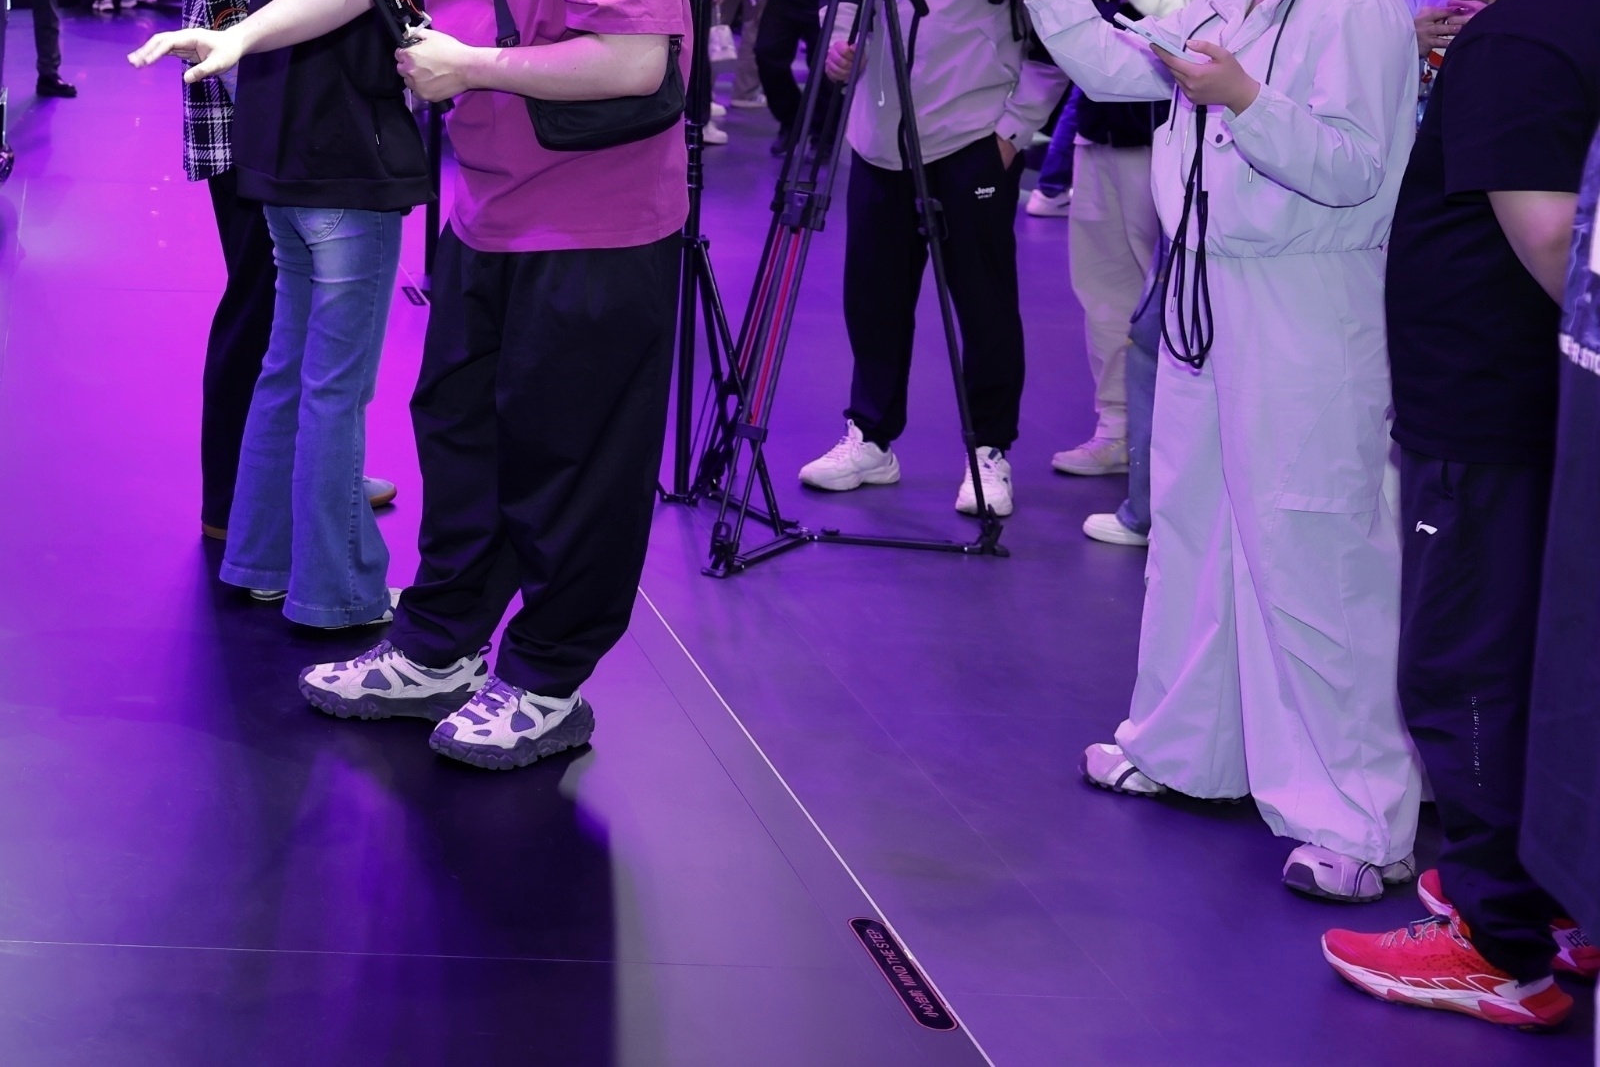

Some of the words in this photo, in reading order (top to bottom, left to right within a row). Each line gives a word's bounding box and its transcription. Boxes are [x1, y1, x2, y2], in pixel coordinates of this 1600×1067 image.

[975, 186, 995, 195] Jeep
[866, 928, 890, 949] STEP
[880, 949, 901, 965] THE
[892, 965, 917, 986] MIND
